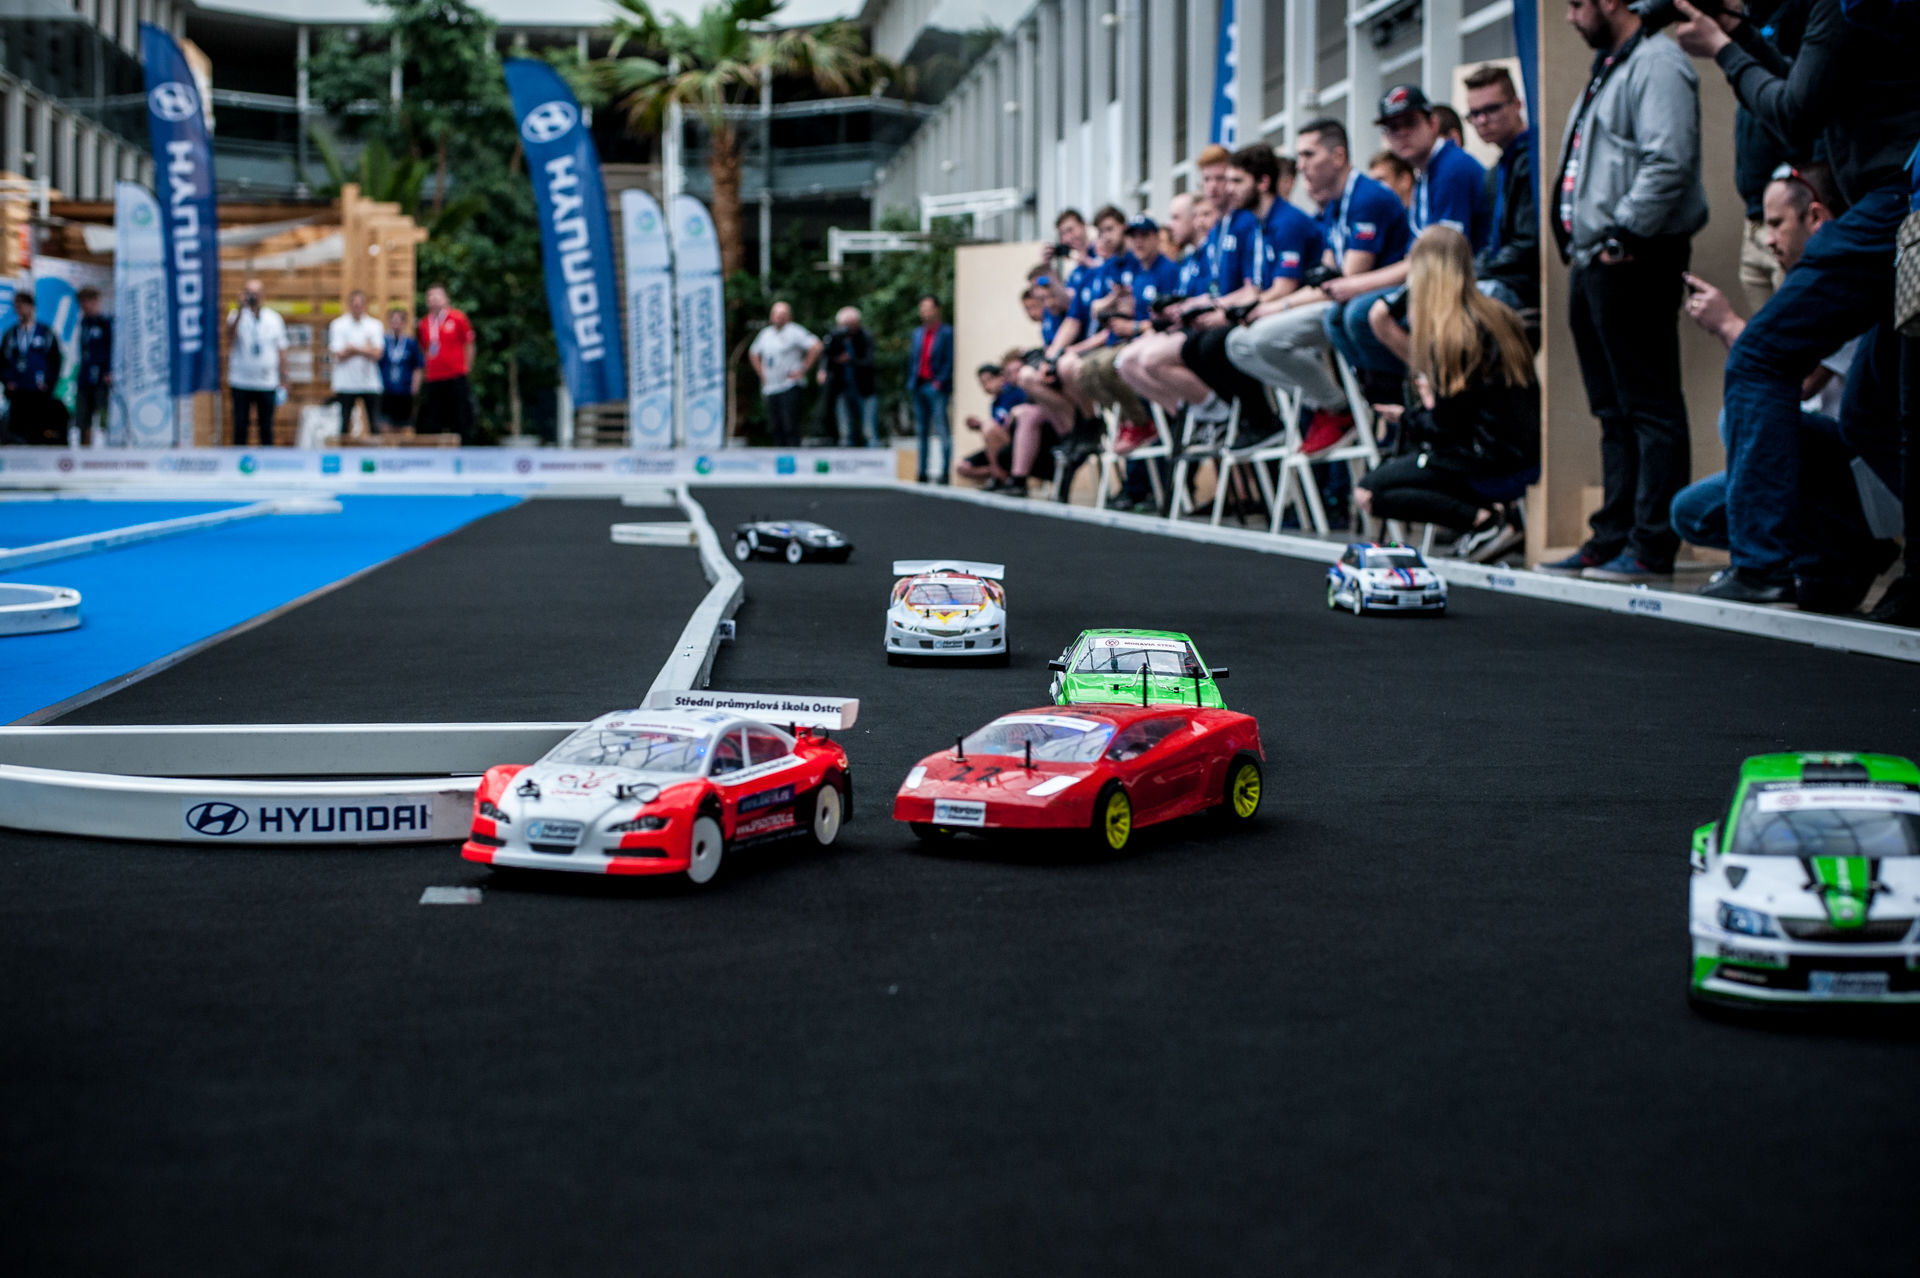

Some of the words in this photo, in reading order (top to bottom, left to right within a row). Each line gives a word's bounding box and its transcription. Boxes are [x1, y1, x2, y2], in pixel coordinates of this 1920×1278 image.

[675, 696, 714, 707] Střední
[716, 698, 779, 711] průmyslová
[781, 700, 810, 712] škola
[259, 804, 428, 833] HYUNDAI
